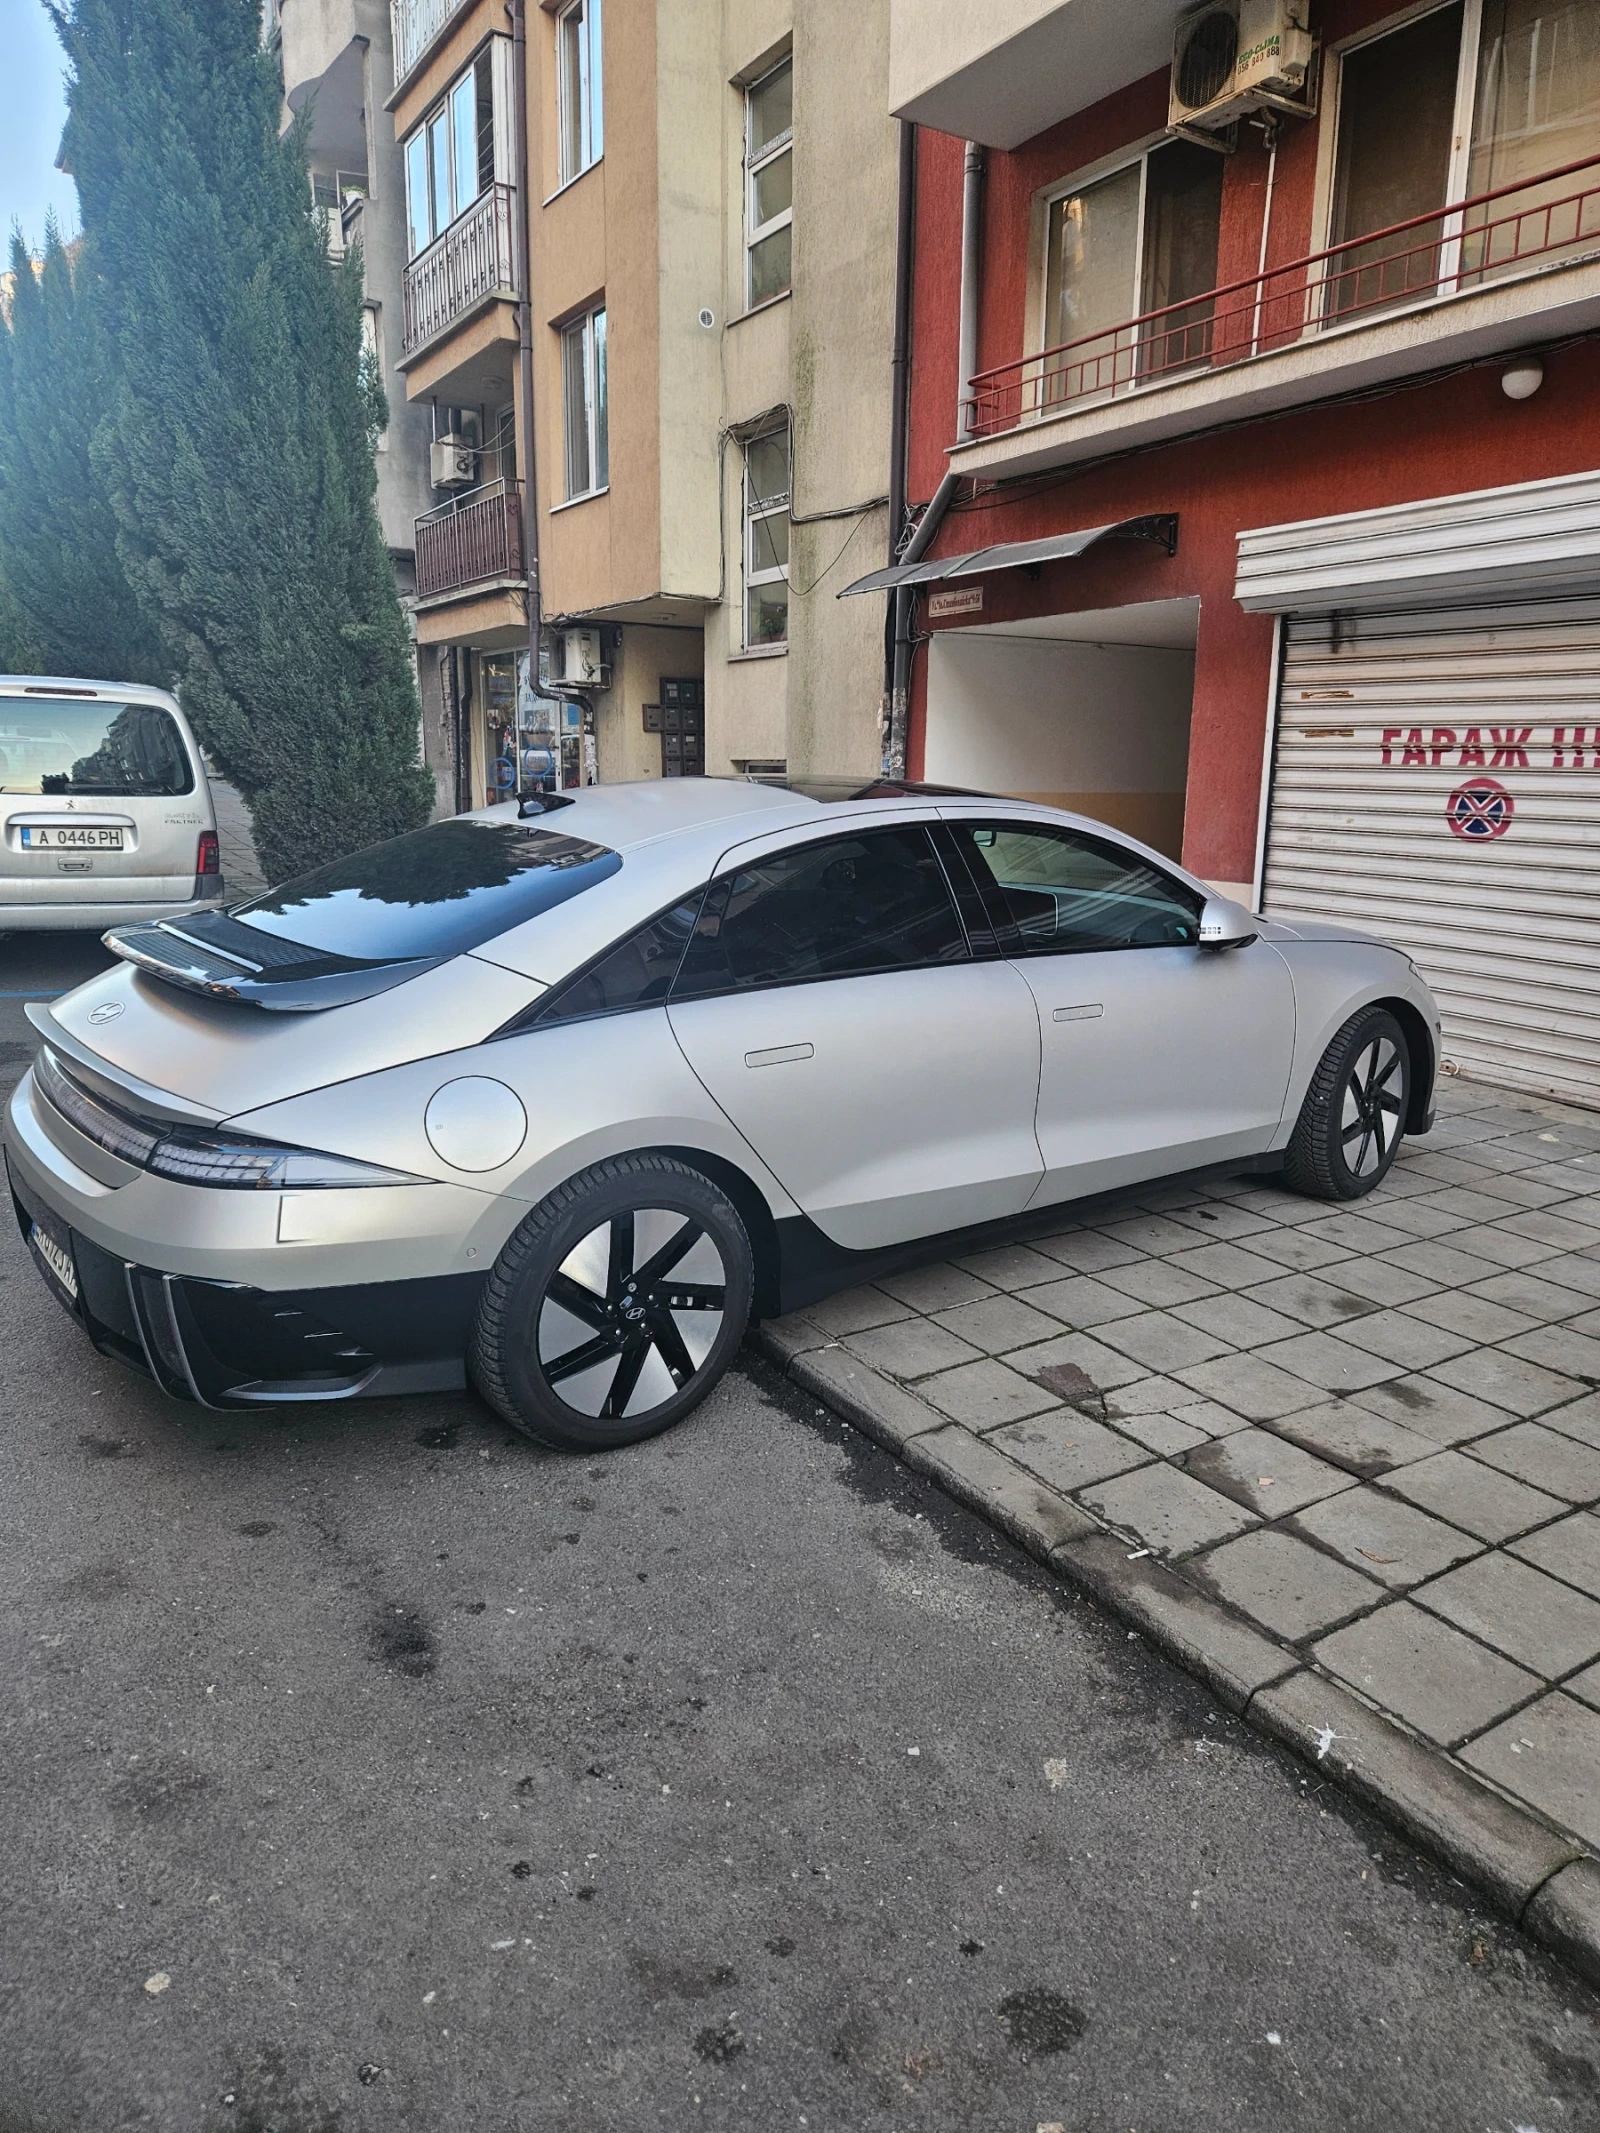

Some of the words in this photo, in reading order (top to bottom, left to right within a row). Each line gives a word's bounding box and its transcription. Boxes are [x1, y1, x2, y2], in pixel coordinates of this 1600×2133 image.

[1238, 35, 1280, 65] ECO-CLIMA
[1238, 60, 1249, 75] 056
[1266, 45, 1280, 58] 888
[1380, 727, 1534, 767] ГАРАЖ
[39, 830, 49, 845] A
[57, 830, 96, 845] 0446
[98, 831, 120, 845] PH
